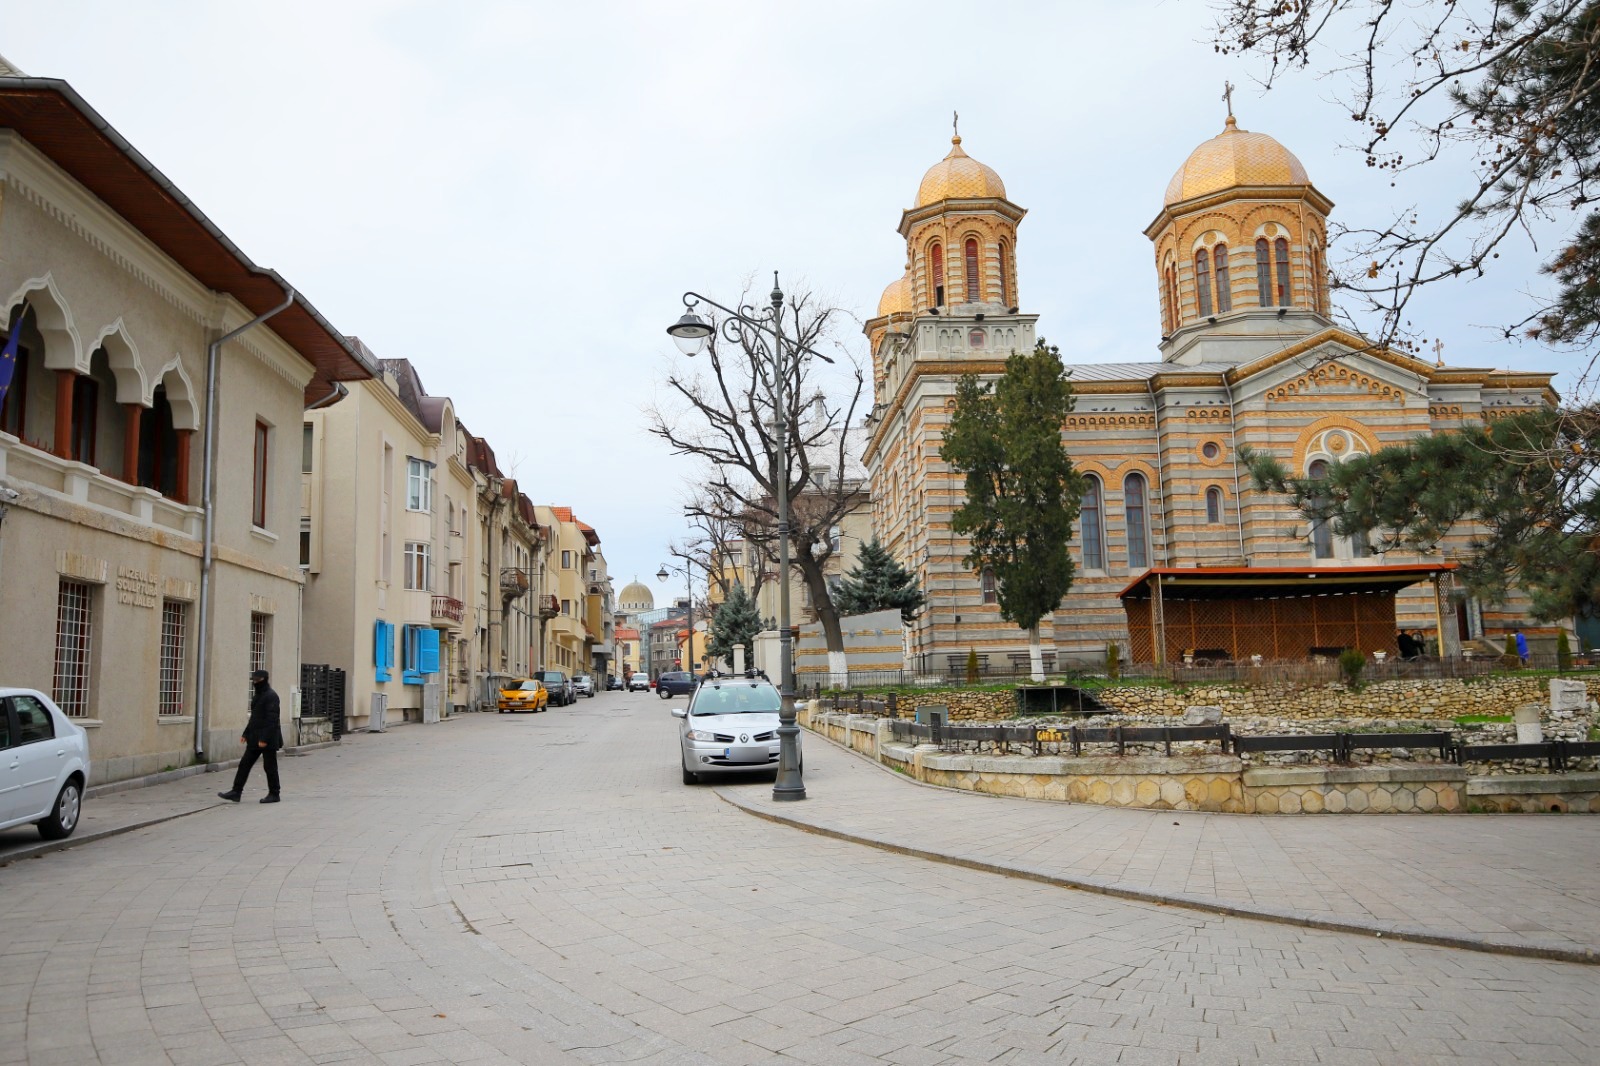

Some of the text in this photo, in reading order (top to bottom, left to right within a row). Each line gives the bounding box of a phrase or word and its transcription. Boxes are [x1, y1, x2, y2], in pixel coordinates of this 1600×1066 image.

[118, 565, 158, 584] MUZEUL DE
[119, 592, 155, 608] ION JALEA
